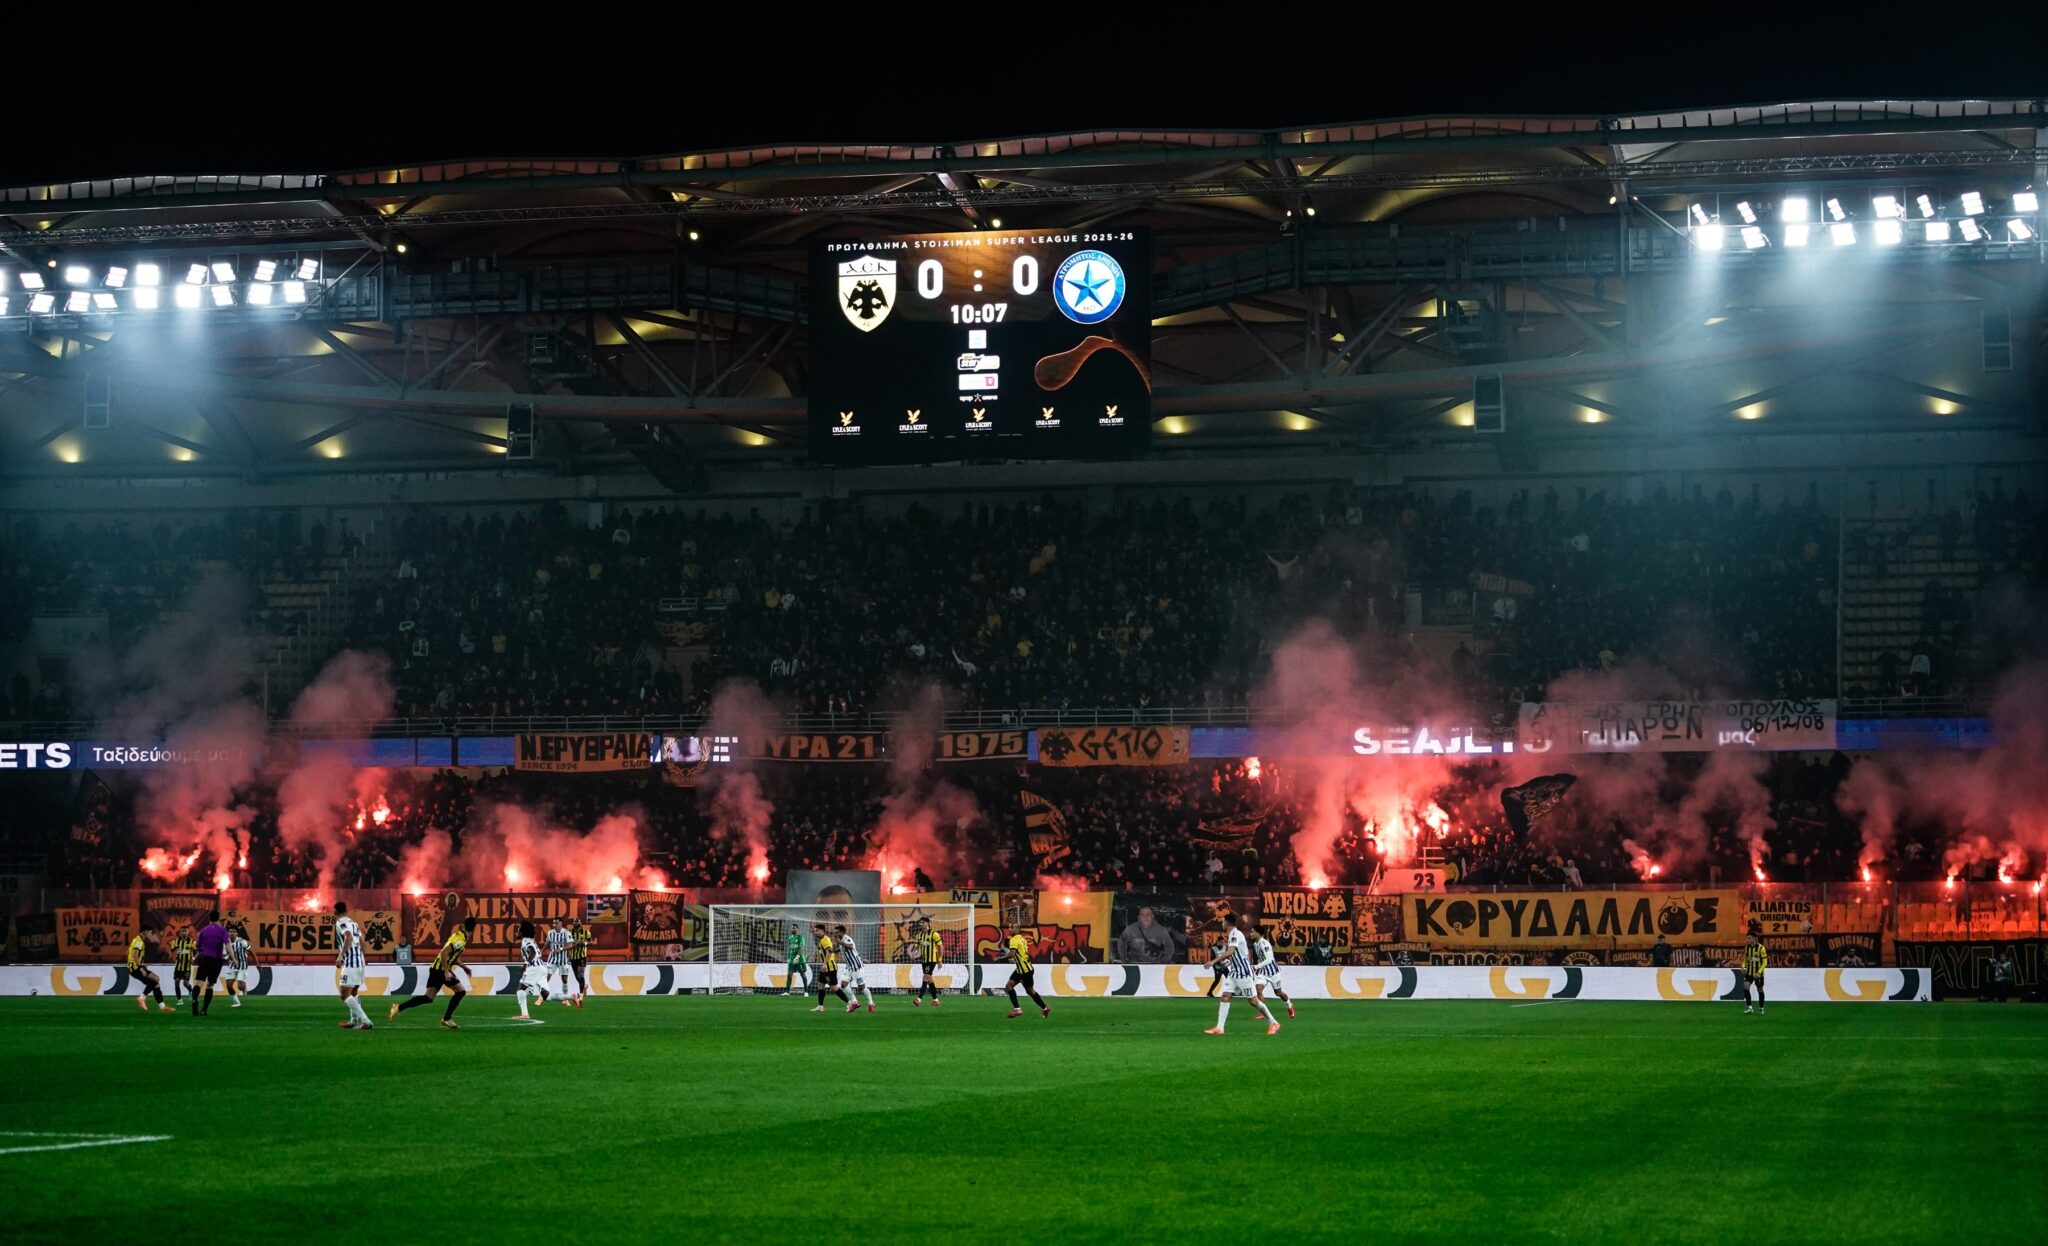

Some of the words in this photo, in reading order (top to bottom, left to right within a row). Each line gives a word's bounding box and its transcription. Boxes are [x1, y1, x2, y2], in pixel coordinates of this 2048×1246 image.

[828, 241, 908, 251] ΠΡΩΤΑΘΛΗΜΑ
[986, 237, 1025, 246] SUPER
[1031, 235, 1078, 244] LEAGUE
[1084, 232, 1134, 242] 2025-26
[918, 259, 944, 300] 0
[1012, 255, 1039, 296] 0
[950, 303, 1008, 325] 10:07
[838, 735, 875, 758] 21
[937, 731, 1025, 758] 1975
[1413, 872, 1436, 890] 23
[464, 898, 580, 919] MENIDI
[1263, 891, 1319, 914] NEOS
[1353, 895, 1401, 906] SOUTH
[1750, 901, 1811, 913] ALIARTOS
[278, 914, 315, 925] SINCE
[1773, 923, 1789, 932] 21
[1828, 935, 1874, 950] ORIGINAL
